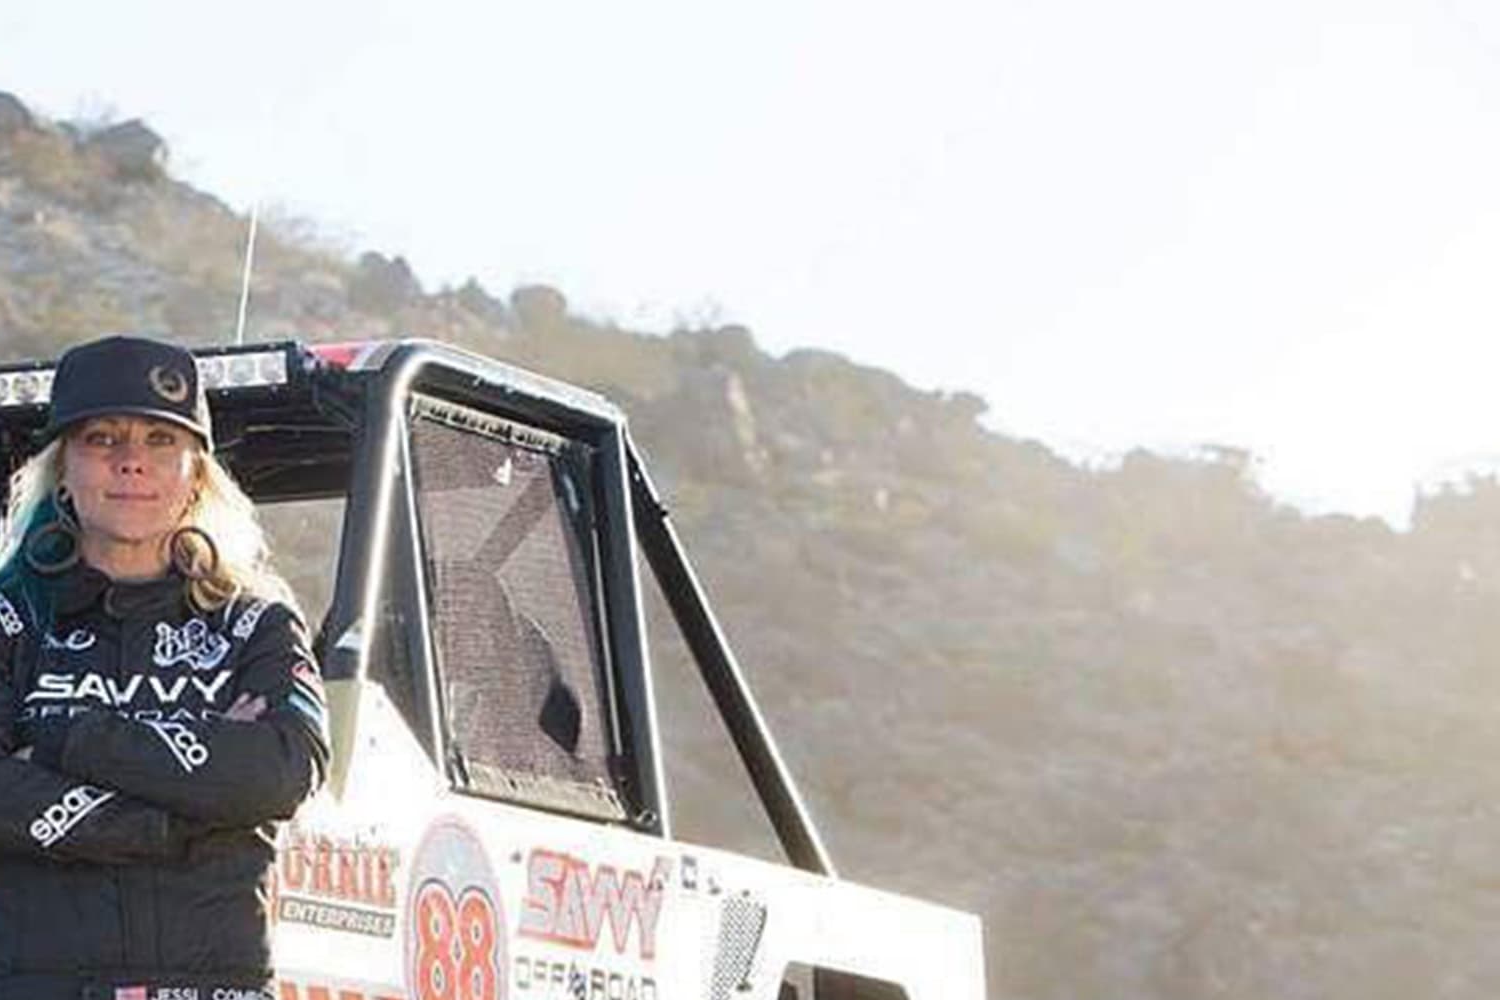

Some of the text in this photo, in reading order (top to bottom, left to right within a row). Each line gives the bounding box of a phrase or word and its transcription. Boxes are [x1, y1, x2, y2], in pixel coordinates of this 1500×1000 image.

[24, 670, 232, 704] SAVVY
[30, 785, 116, 847] spar
[516, 847, 676, 960] SAVVY
